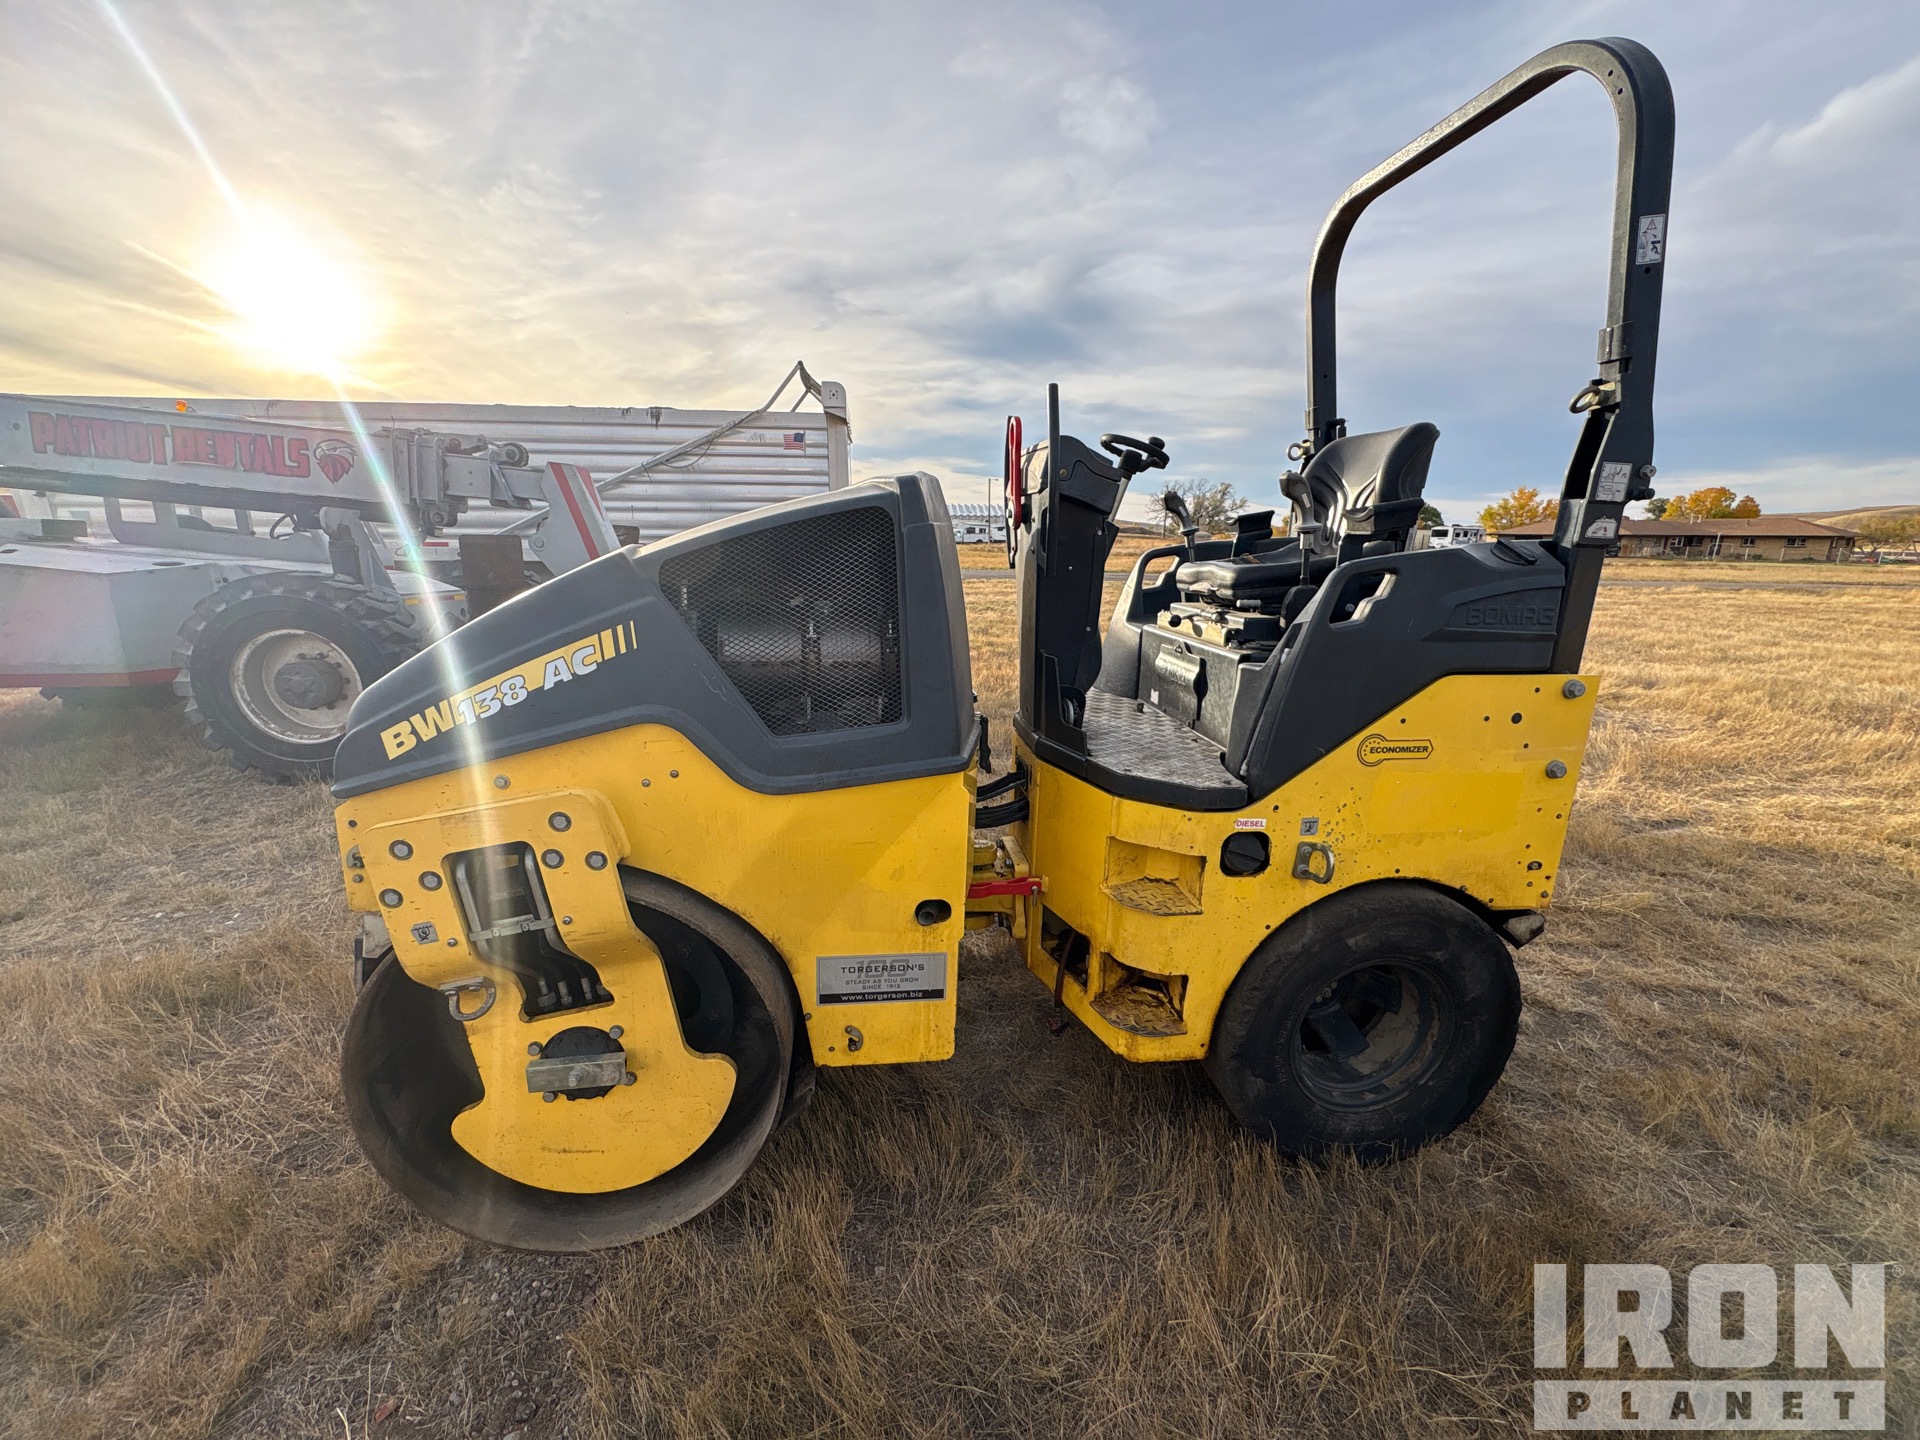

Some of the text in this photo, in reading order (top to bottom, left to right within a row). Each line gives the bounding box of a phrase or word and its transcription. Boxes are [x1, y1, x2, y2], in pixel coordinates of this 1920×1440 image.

[28, 411, 311, 479] PATRIOT RENTALS
[1465, 606, 1555, 626] BOMAG
[543, 645, 598, 691] AC
[1369, 745, 1429, 754] ECONOMIZER
[1236, 820, 1265, 828] DIESEL
[840, 964, 925, 974] TORGERSON'S
[841, 991, 923, 1001] www.torgerson.biz
